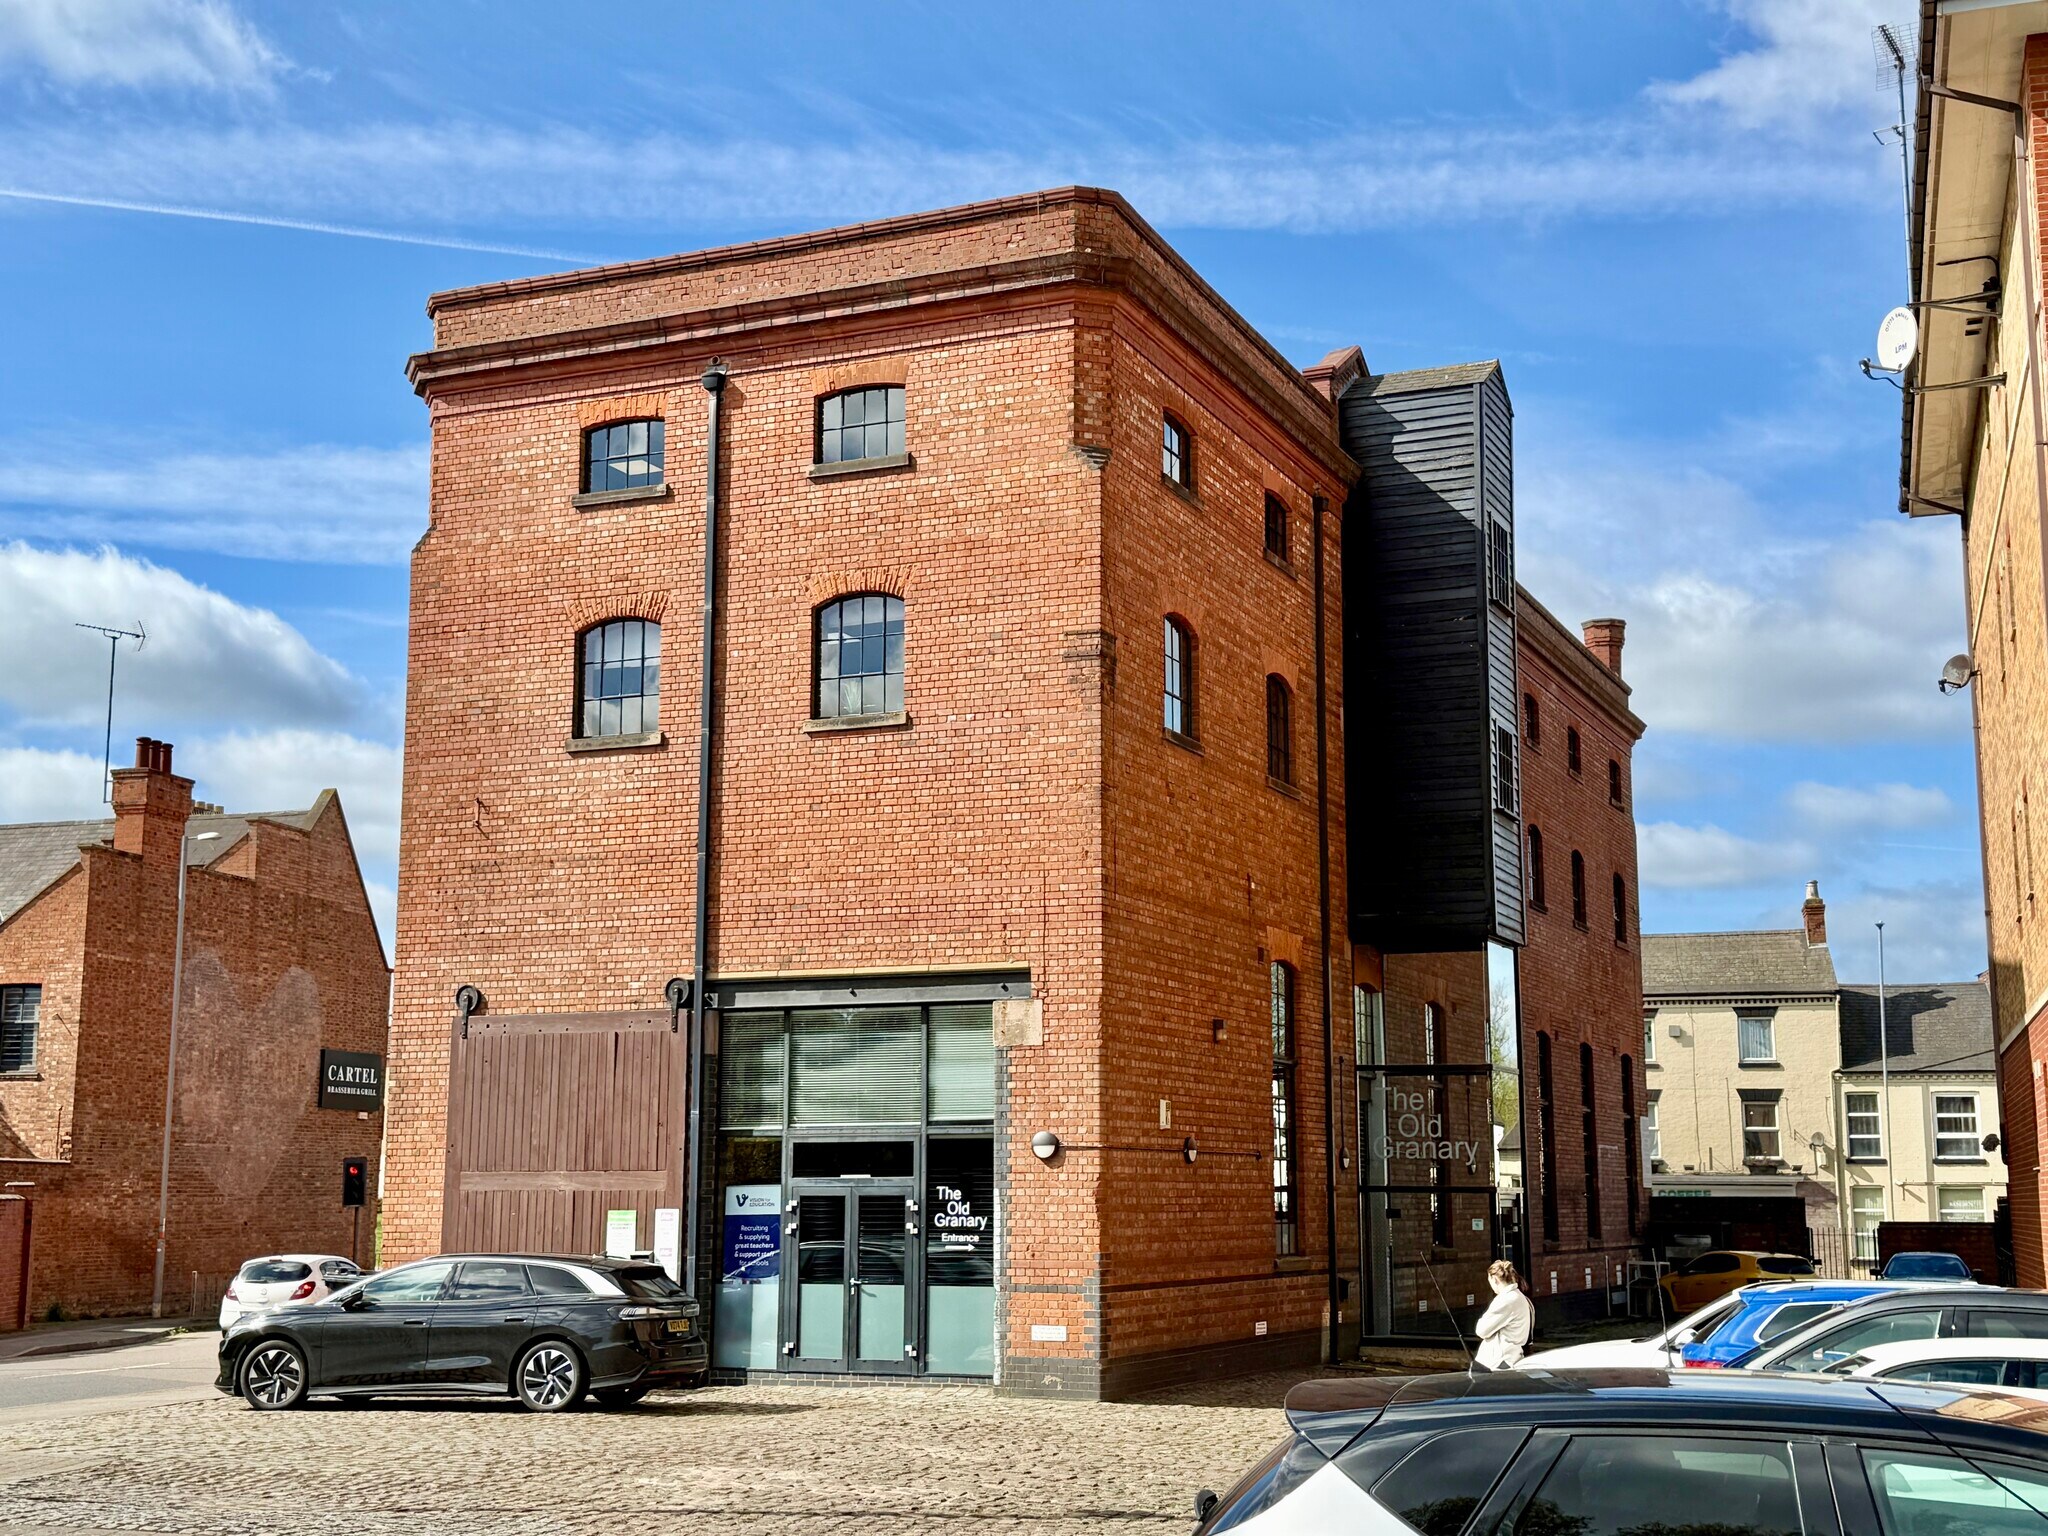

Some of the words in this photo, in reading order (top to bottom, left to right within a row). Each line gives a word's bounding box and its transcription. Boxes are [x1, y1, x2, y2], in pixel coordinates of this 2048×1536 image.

[328, 1065, 377, 1083] CARTEL
[1375, 1086, 1425, 1112] The
[1397, 1113, 1443, 1138] Old
[1373, 1136, 1479, 1165] Granary
[936, 1186, 962, 1200] The
[947, 1201, 970, 1215] Old
[934, 1213, 987, 1230] Granary
[941, 1233, 979, 1241] Entrance
[739, 1251, 760, 1259] support
